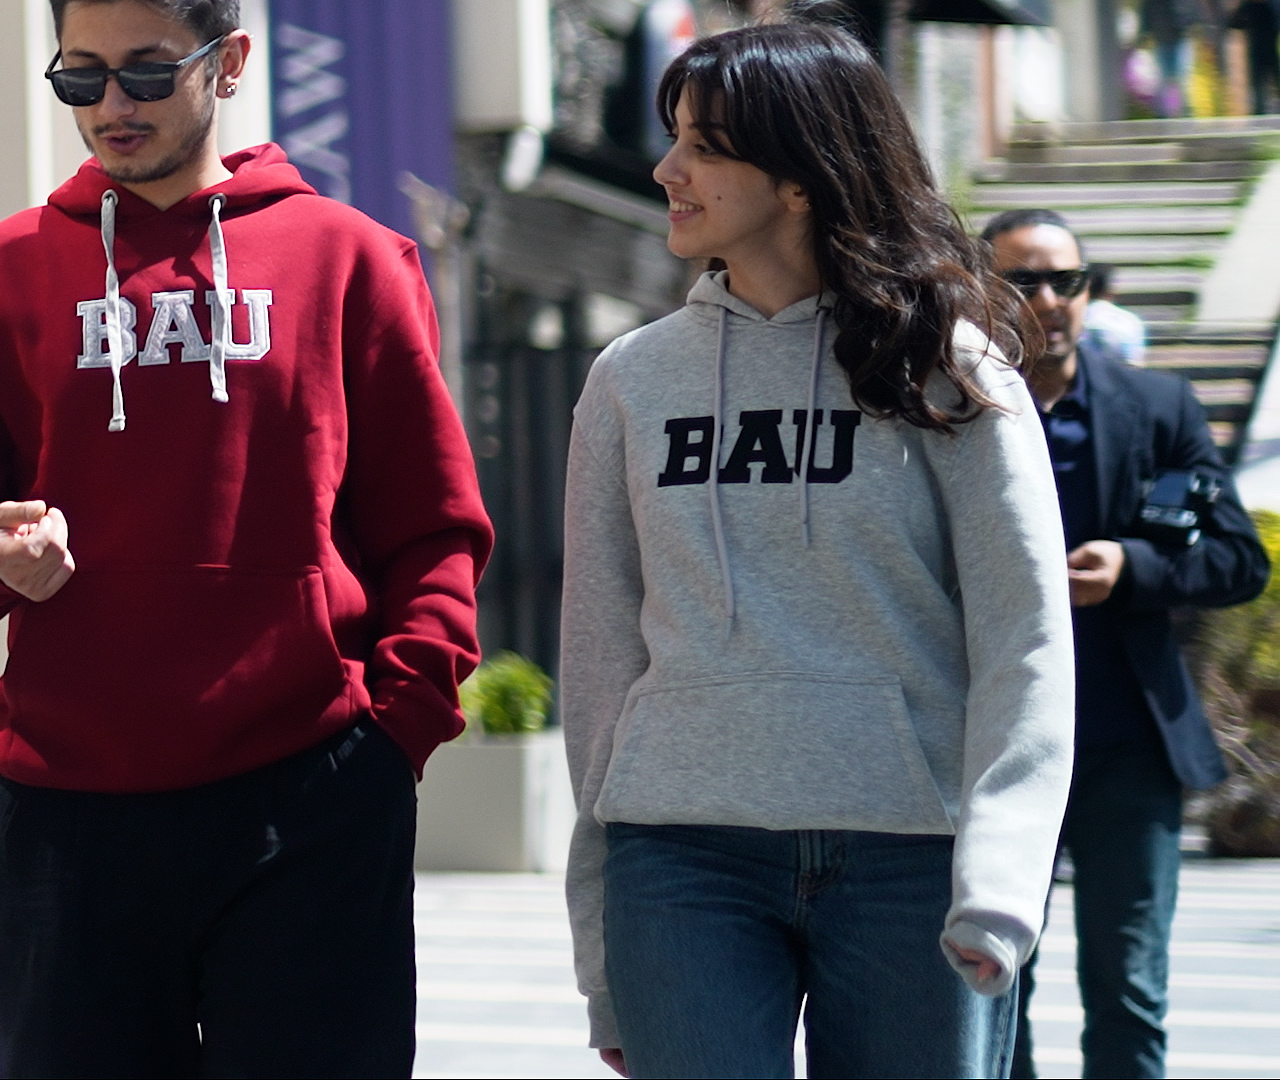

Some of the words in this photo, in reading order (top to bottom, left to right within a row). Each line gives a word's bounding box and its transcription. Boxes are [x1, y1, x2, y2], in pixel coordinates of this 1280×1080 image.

[277, 22, 352, 204] AW
[76, 289, 273, 369] BAU
[657, 409, 861, 487] BAU
